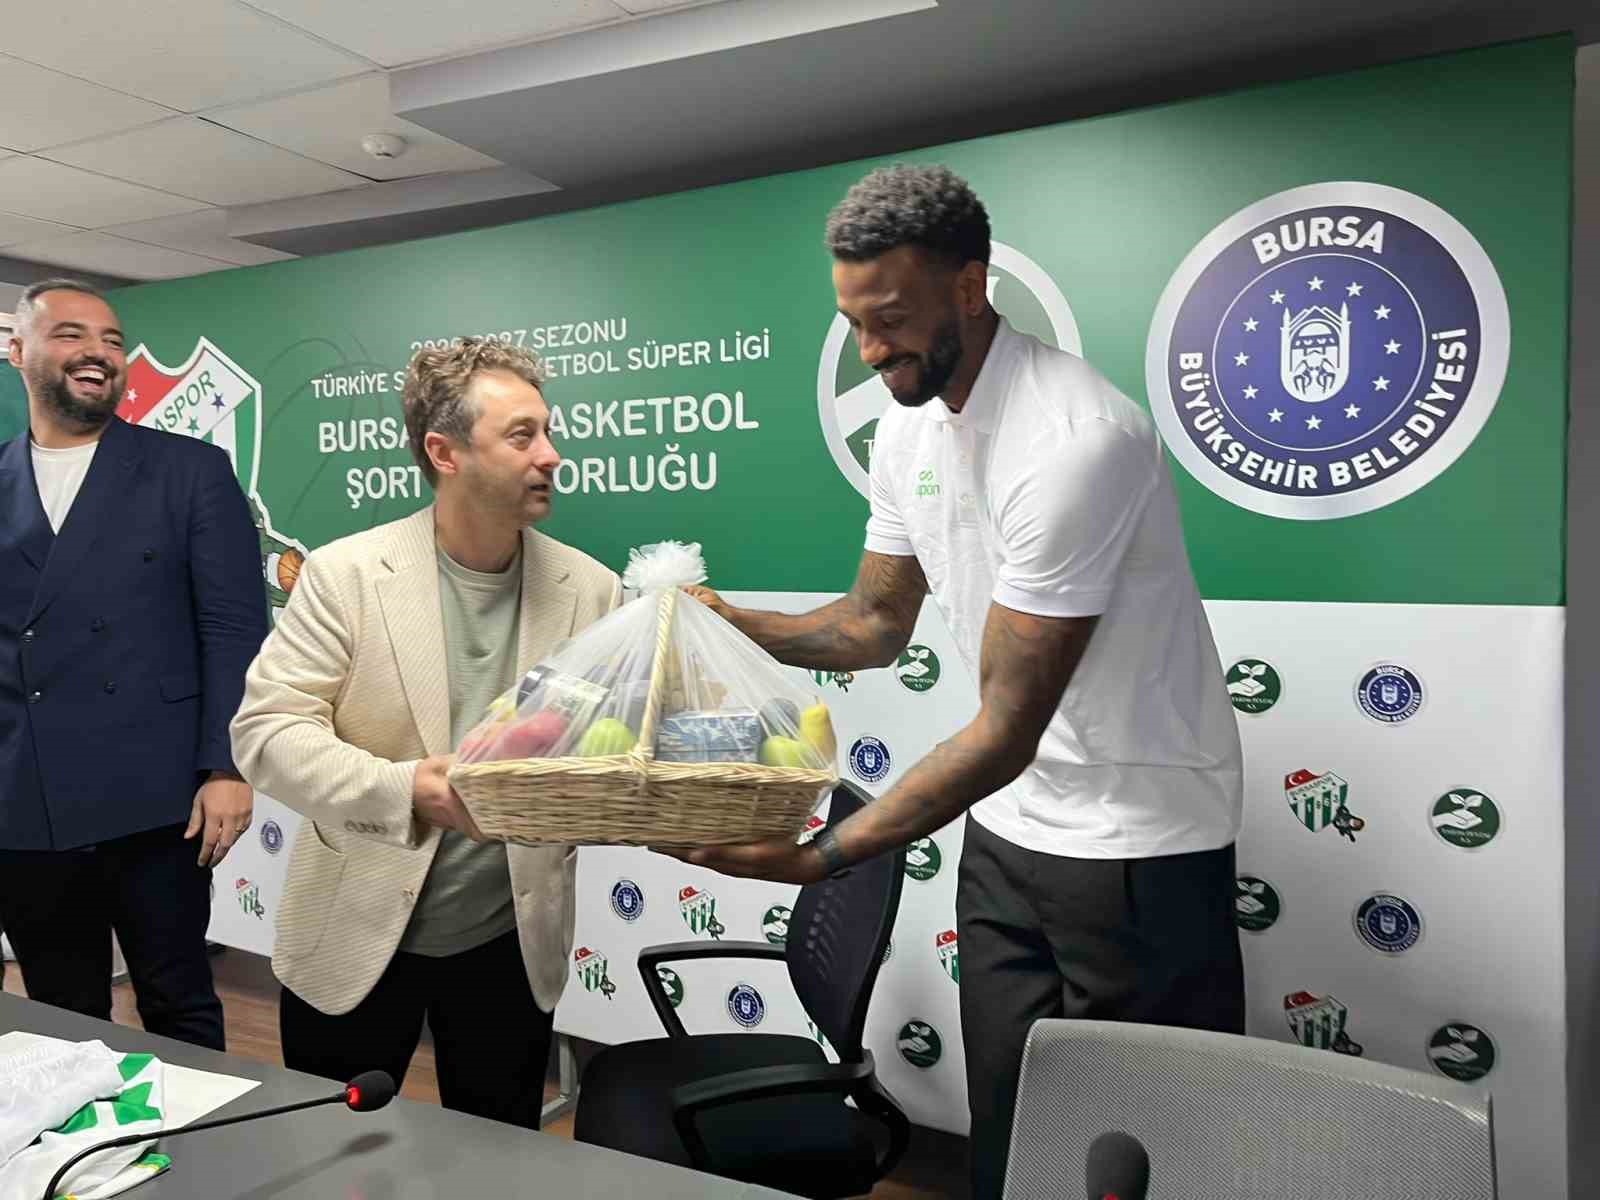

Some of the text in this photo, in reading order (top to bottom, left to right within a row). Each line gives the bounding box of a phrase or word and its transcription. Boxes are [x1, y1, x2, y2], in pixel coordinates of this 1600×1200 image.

[1252, 215, 1385, 264] BURSA
[310, 369, 389, 399] TÜRKİYE
[538, 350, 621, 378] ETBOL
[627, 339, 711, 371] SÜPER
[719, 327, 769, 363] LİGİ
[532, 317, 627, 349] SEZONU
[154, 369, 216, 432] ASPOR
[318, 390, 760, 453] BURSA ASKETBOL
[1178, 327, 1468, 489] BÜYÜKŞEHİR BELEDİYESİ
[346, 442, 718, 508] ŞORT ORLUĞU
